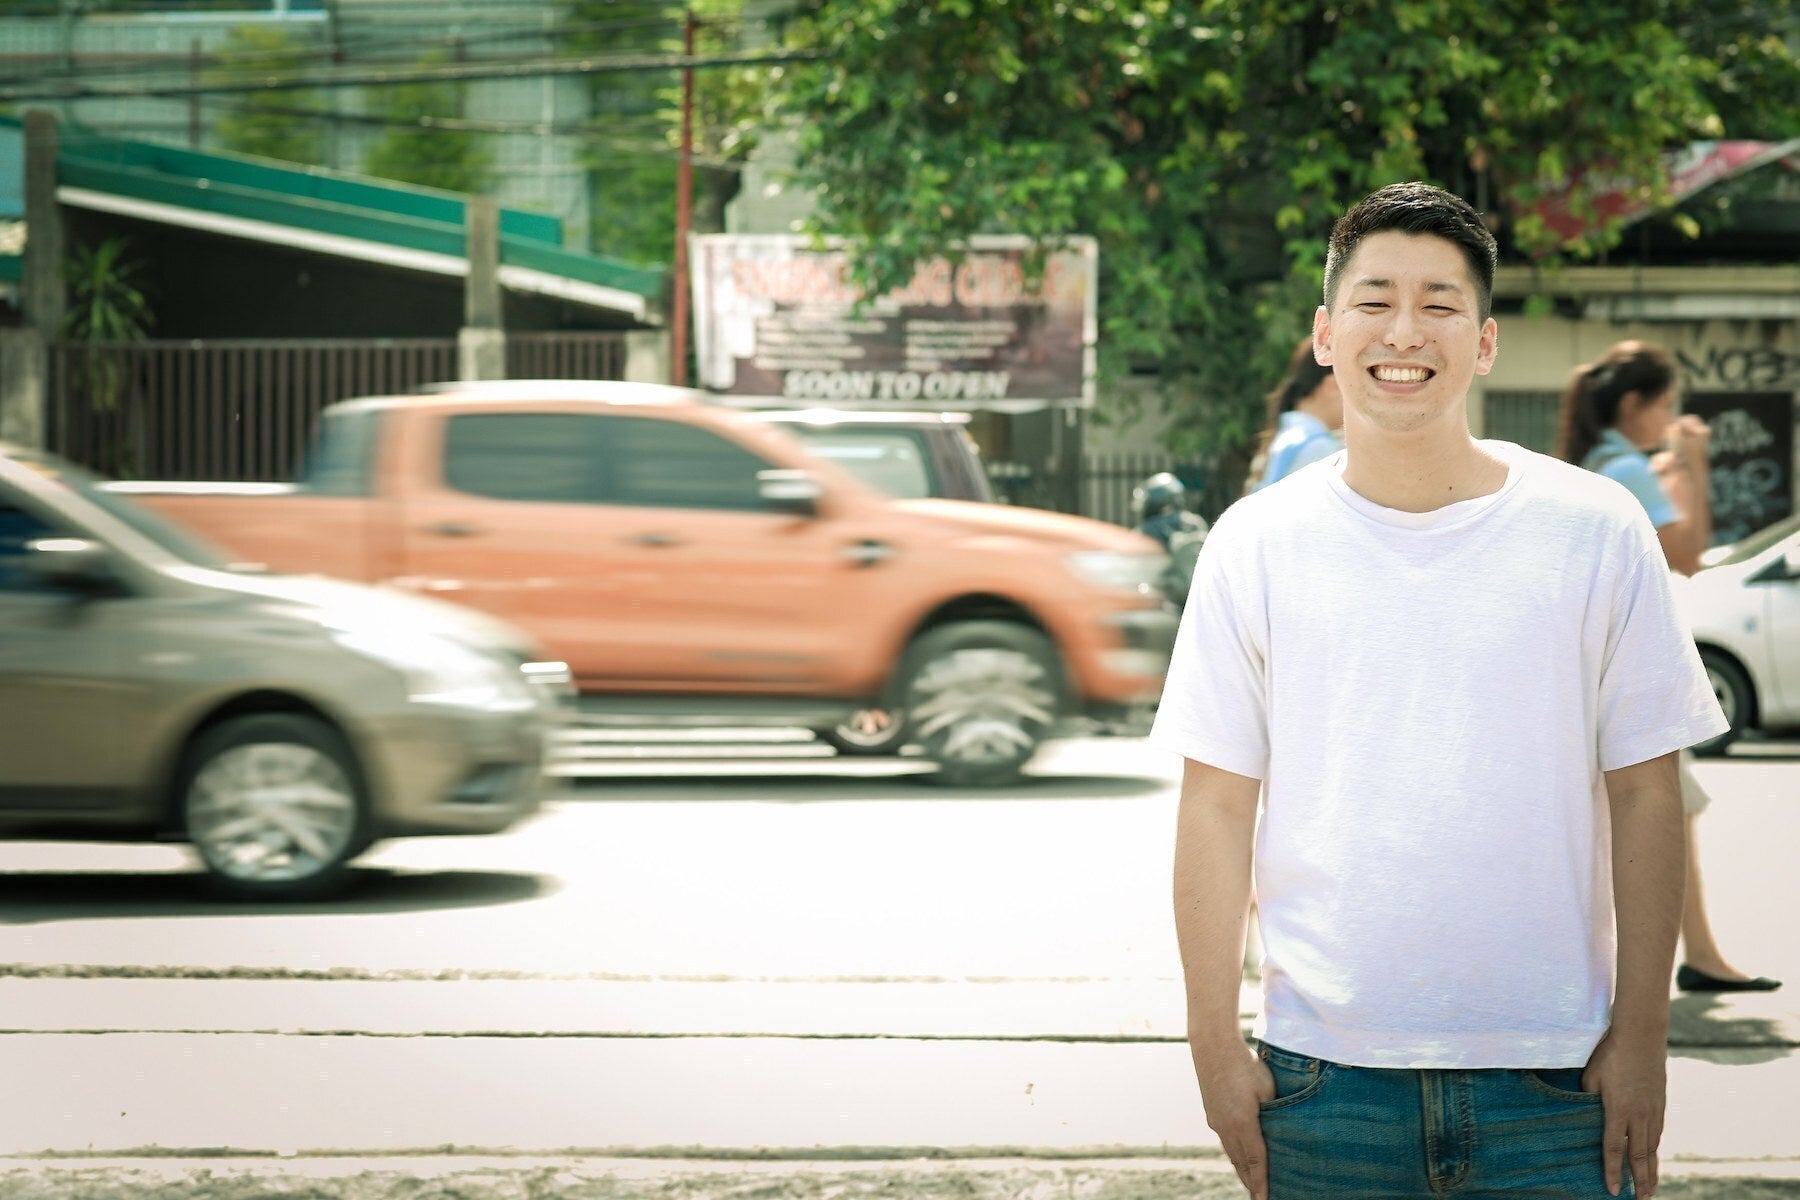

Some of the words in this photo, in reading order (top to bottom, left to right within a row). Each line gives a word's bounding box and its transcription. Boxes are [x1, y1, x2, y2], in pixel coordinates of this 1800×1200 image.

[784, 370, 875, 399] SOON
[876, 371, 922, 399] TO
[923, 370, 1010, 399] OPEN
